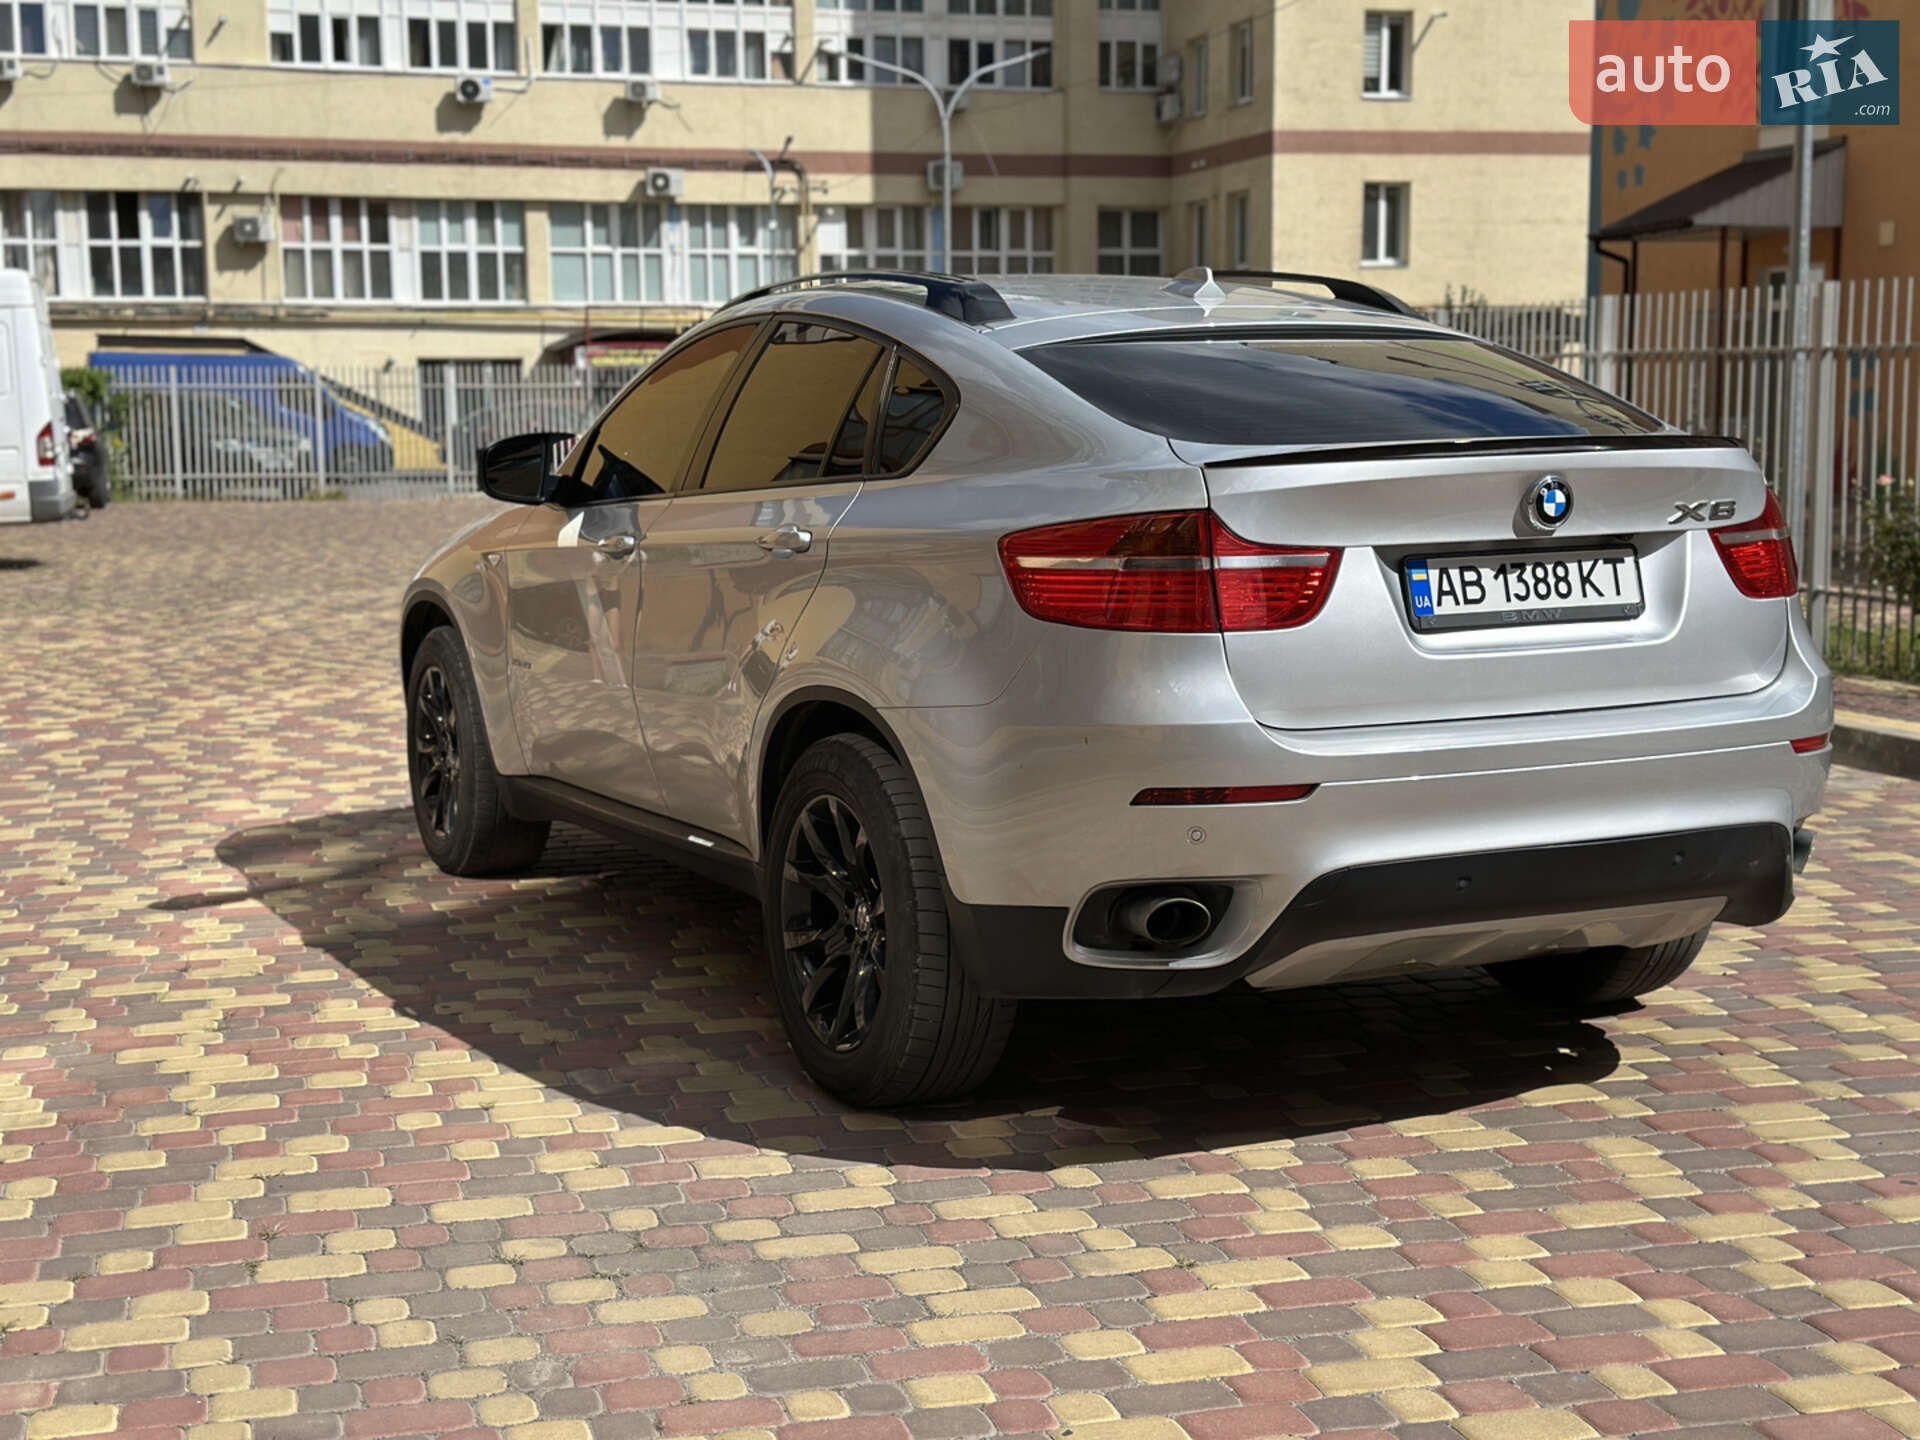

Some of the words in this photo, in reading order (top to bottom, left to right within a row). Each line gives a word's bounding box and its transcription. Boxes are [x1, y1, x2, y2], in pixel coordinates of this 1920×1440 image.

[1436, 566, 1487, 607] AB
[1492, 560, 1573, 603] 1388
[1576, 557, 1625, 599] KT
[1415, 596, 1432, 609] UA
[1501, 608, 1563, 622] BMW
